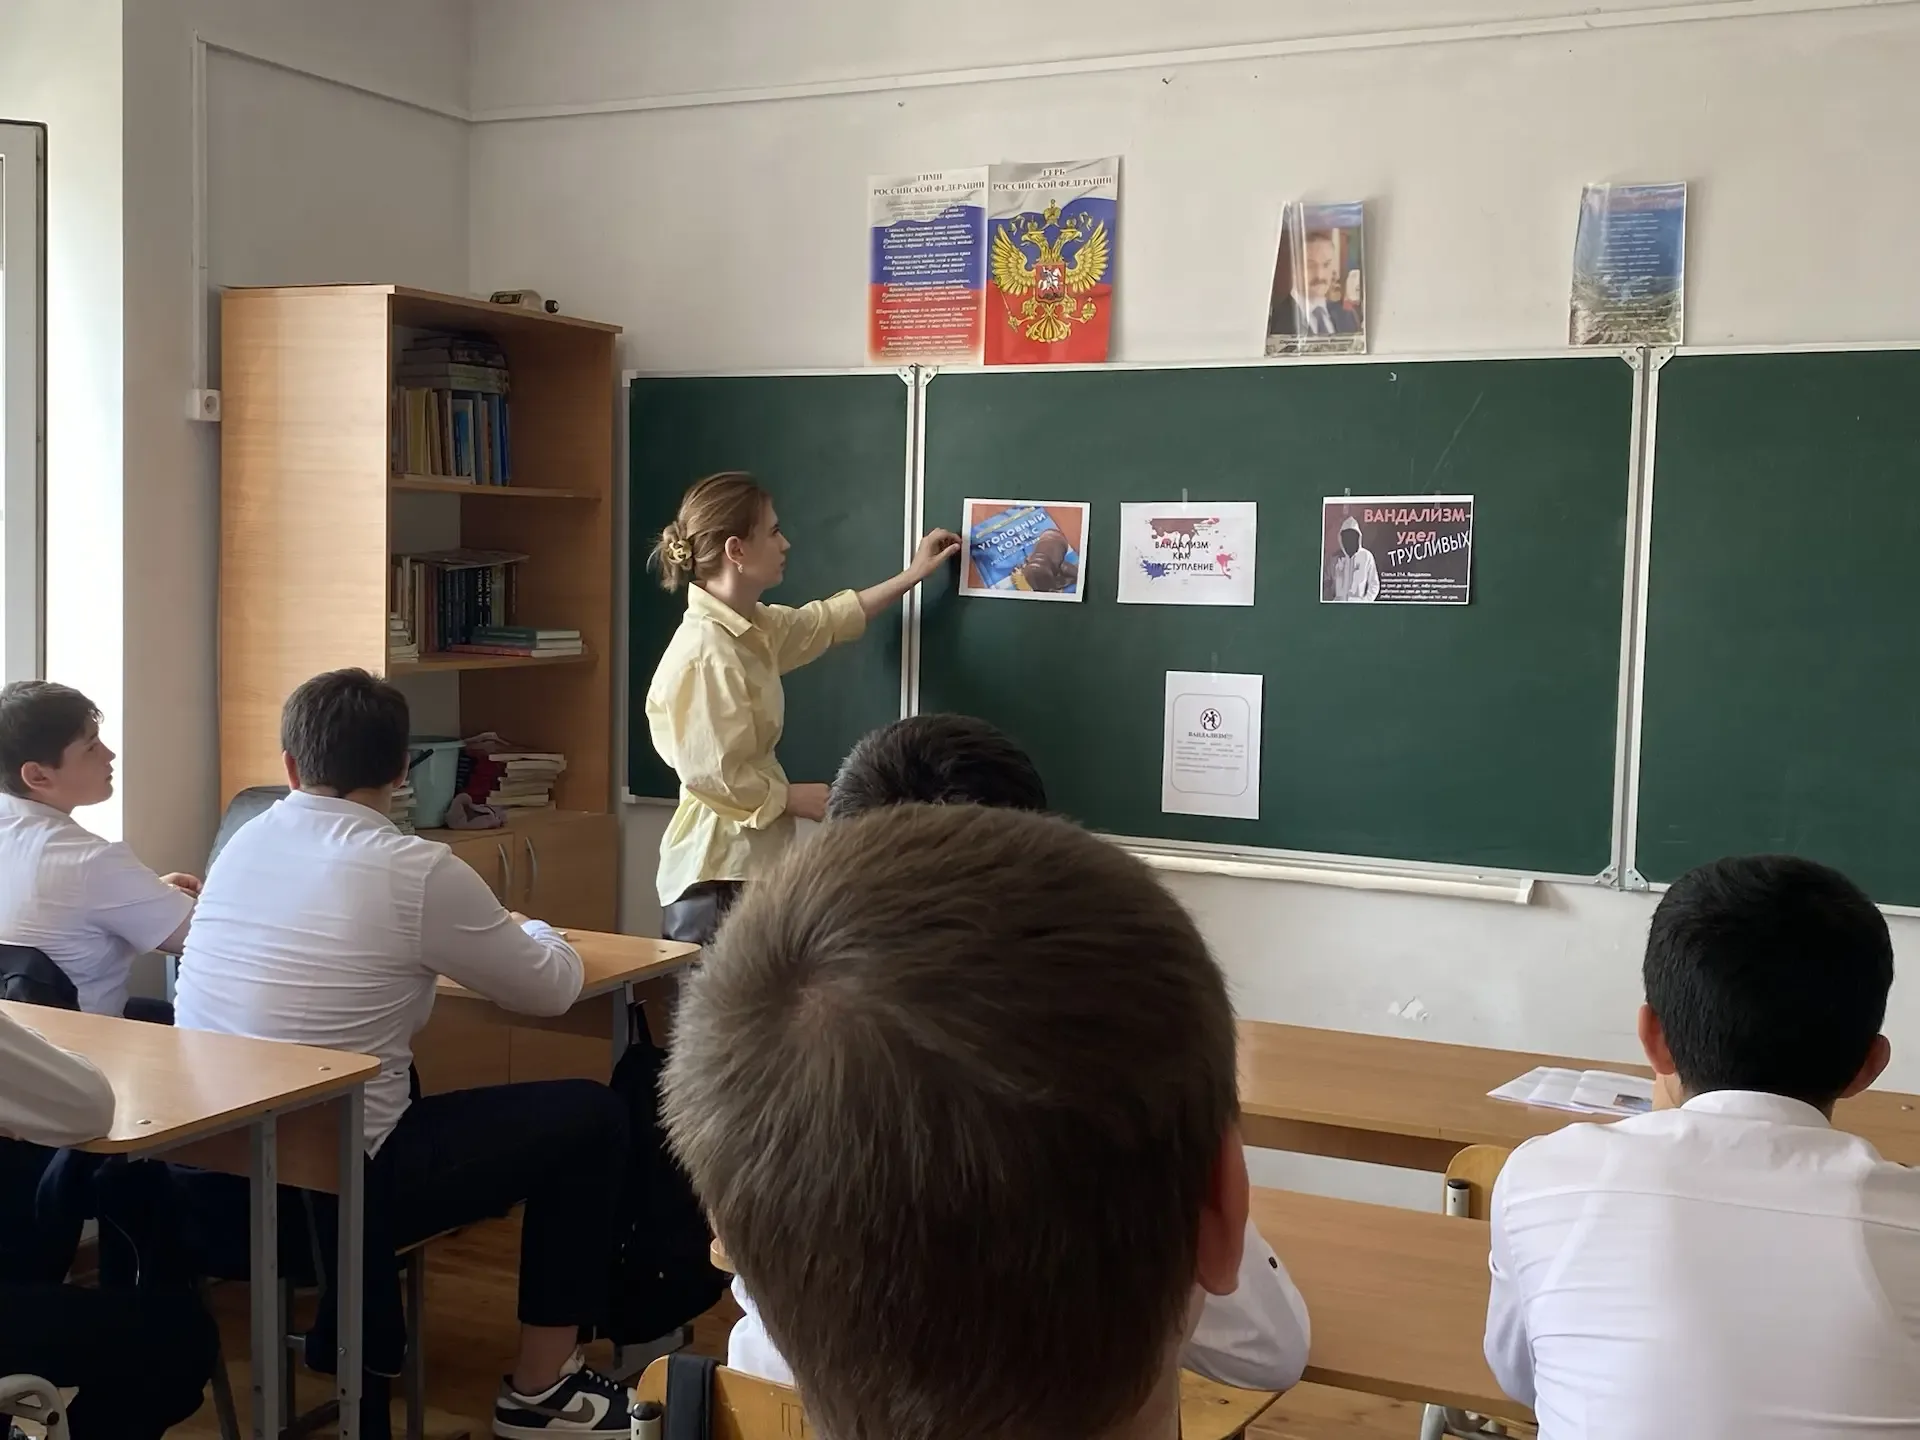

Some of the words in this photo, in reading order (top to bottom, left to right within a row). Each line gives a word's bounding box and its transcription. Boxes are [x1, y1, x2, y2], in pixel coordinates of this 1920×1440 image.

[873, 185, 933, 196] РОССИЙСКОЙ
[934, 181, 985, 192] ФЕДЕРАЦИИ
[993, 180, 1057, 191] РОССИЙСКОЙ
[1058, 176, 1112, 188] ФЕДЕРАЦИИ
[996, 527, 1040, 553] КОДЕКС
[1155, 541, 1209, 550] ВАНДАЛИЗМ
[1396, 531, 1437, 545] удел
[1172, 551, 1191, 561] КАК
[1387, 530, 1471, 567] ТРУСЛИВЫХ
